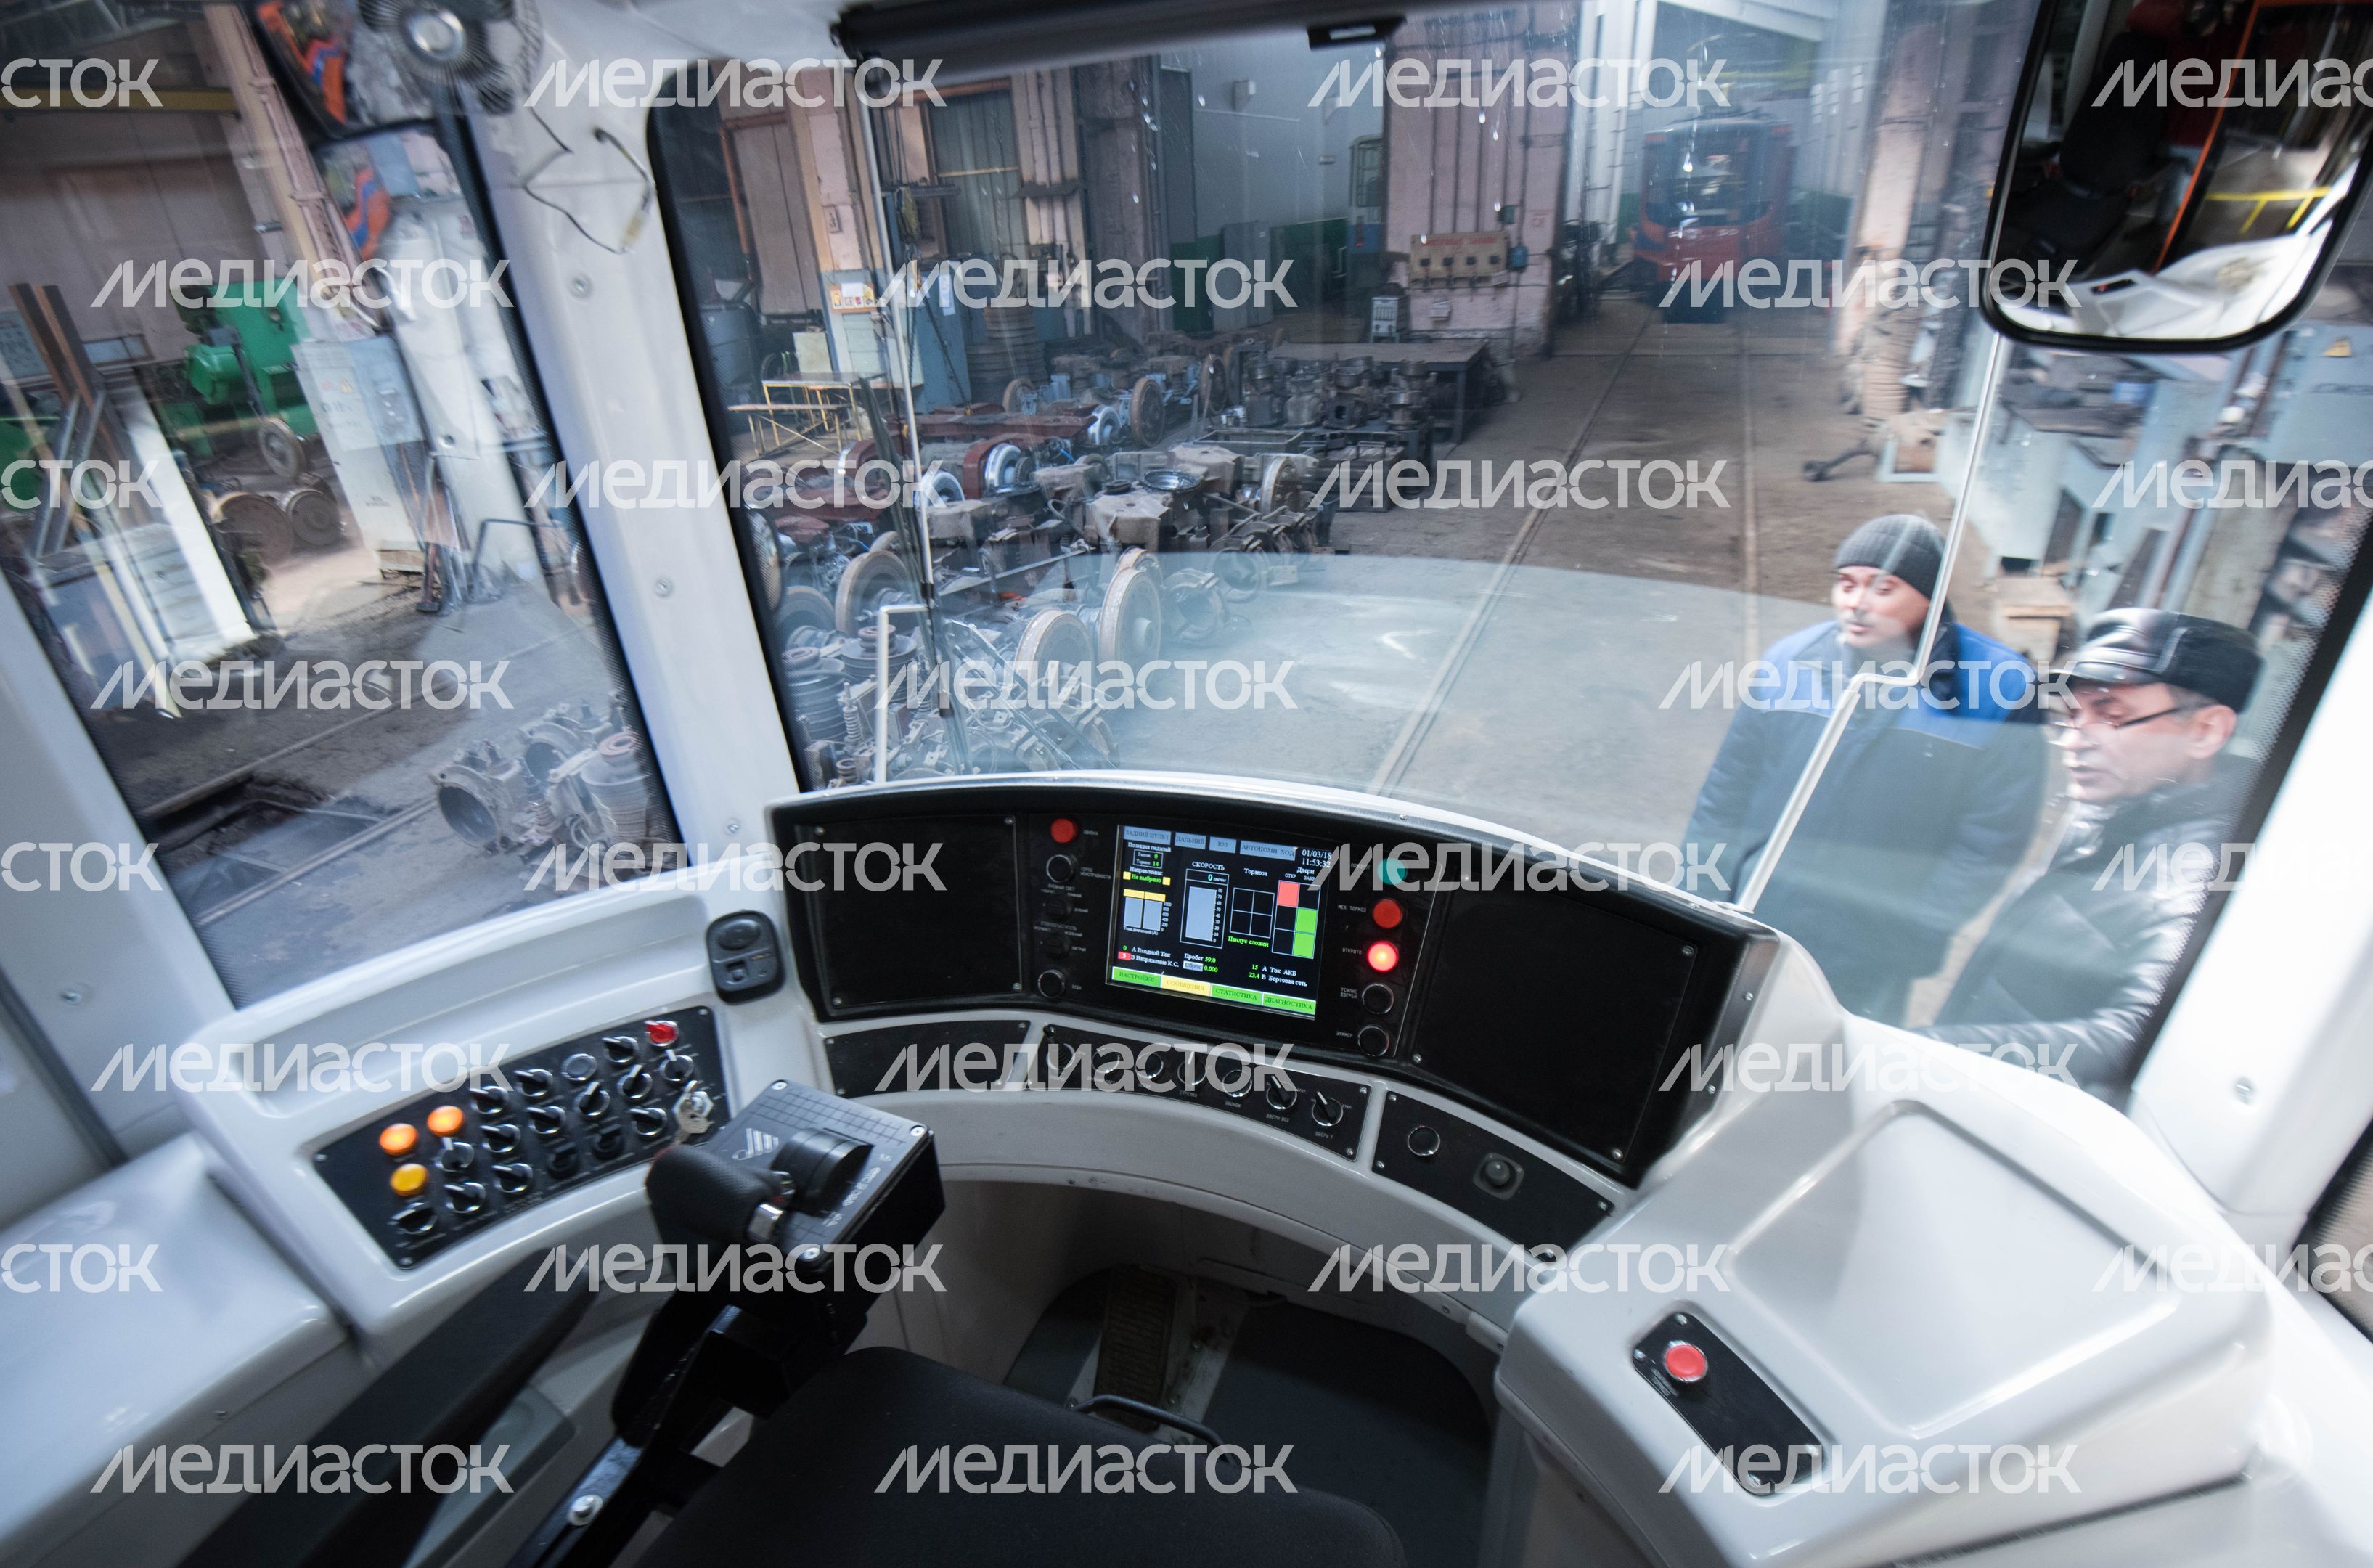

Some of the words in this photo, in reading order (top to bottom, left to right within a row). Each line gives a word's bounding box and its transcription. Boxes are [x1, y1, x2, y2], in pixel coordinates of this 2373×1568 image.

[1176, 836, 1205, 845] ДАЛЬНИЙ
[1302, 849, 1333, 859] 01/03/18
[1192, 861, 1225, 871] СКОРОСТЬ
[1302, 857, 1331, 868] 11:53:32
[1243, 867, 1268, 876] Тормоза
[1184, 952, 1204, 962] Пробег
[1119, 971, 1155, 982] НАСТРОЙКИ
[1268, 976, 1295, 985] Бортовая
[1167, 980, 1205, 991] СООБЩЕНИЯ
[1215, 988, 1257, 1000] СТАТИСТИКА
[1265, 997, 1312, 1010] ДИАГНОСТИКА
